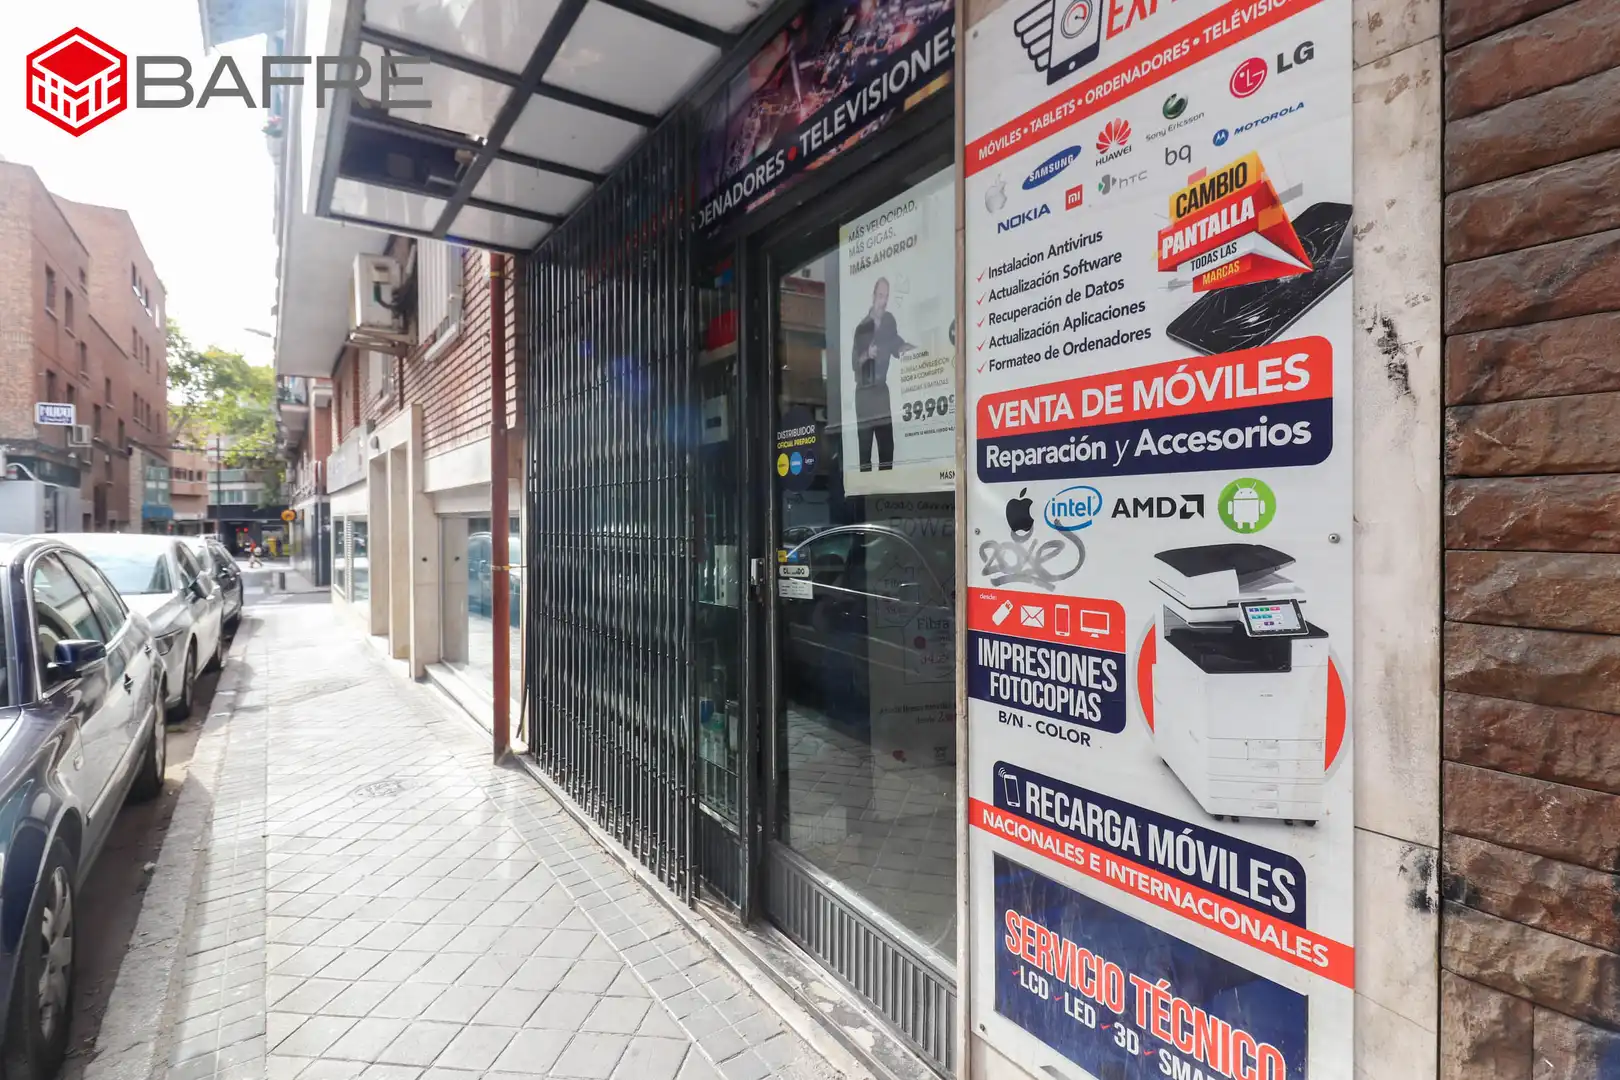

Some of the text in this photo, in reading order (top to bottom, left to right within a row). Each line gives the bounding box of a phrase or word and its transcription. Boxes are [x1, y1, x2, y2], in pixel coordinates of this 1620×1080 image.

[1277, 40, 1315, 74] LG
[978, 127, 1022, 161] MÓVILES
[1030, 102, 1075, 133] TABLETS
[1085, 39, 1190, 104] ORDENADORES
[1234, 101, 1305, 136] MOTOROLA
[1145, 112, 1205, 142] Sony Ericsson
[1029, 154, 1074, 182] SAMSUNG
[1095, 145, 1132, 167] HUAWEI
[1165, 144, 1192, 166] bq
[1118, 170, 1148, 190] htc
[1176, 161, 1248, 218] CAMBIO
[997, 203, 1051, 234] NOKIA
[1162, 195, 1256, 260] PANTALLA
[988, 230, 1103, 279] Instalacion Antivirus
[988, 251, 1122, 302] Actualización Software
[1191, 242, 1238, 271] TODAS LAS
[1202, 260, 1240, 286] MARCAS
[988, 278, 1125, 326] Recuperación de Datos
[988, 300, 1146, 349] Actualización Aplicaciones
[989, 327, 1152, 372] Formateo de Ordenadores
[987, 352, 1310, 430] VENTA DE MÓVILES
[777, 425, 816, 440] DISTRIBUIDOR
[985, 416, 1312, 473] Reparación y Accesorios
[1051, 496, 1092, 517] intel
[1111, 497, 1177, 520] AMD
[978, 637, 1118, 693] IMPRESIONES
[990, 671, 1102, 723] FOTOCOPIAS
[998, 710, 1024, 730] B/N
[1035, 721, 1091, 748] COLOR
[1025, 780, 1297, 915] RECARGA MÓVILES
[982, 808, 1329, 969] NACIONALES E INTERNACIONALES
[1004, 909, 1287, 1080] SERVICIO TÉCNICO
[1020, 966, 1220, 1080] LCD LED 3D SMA
